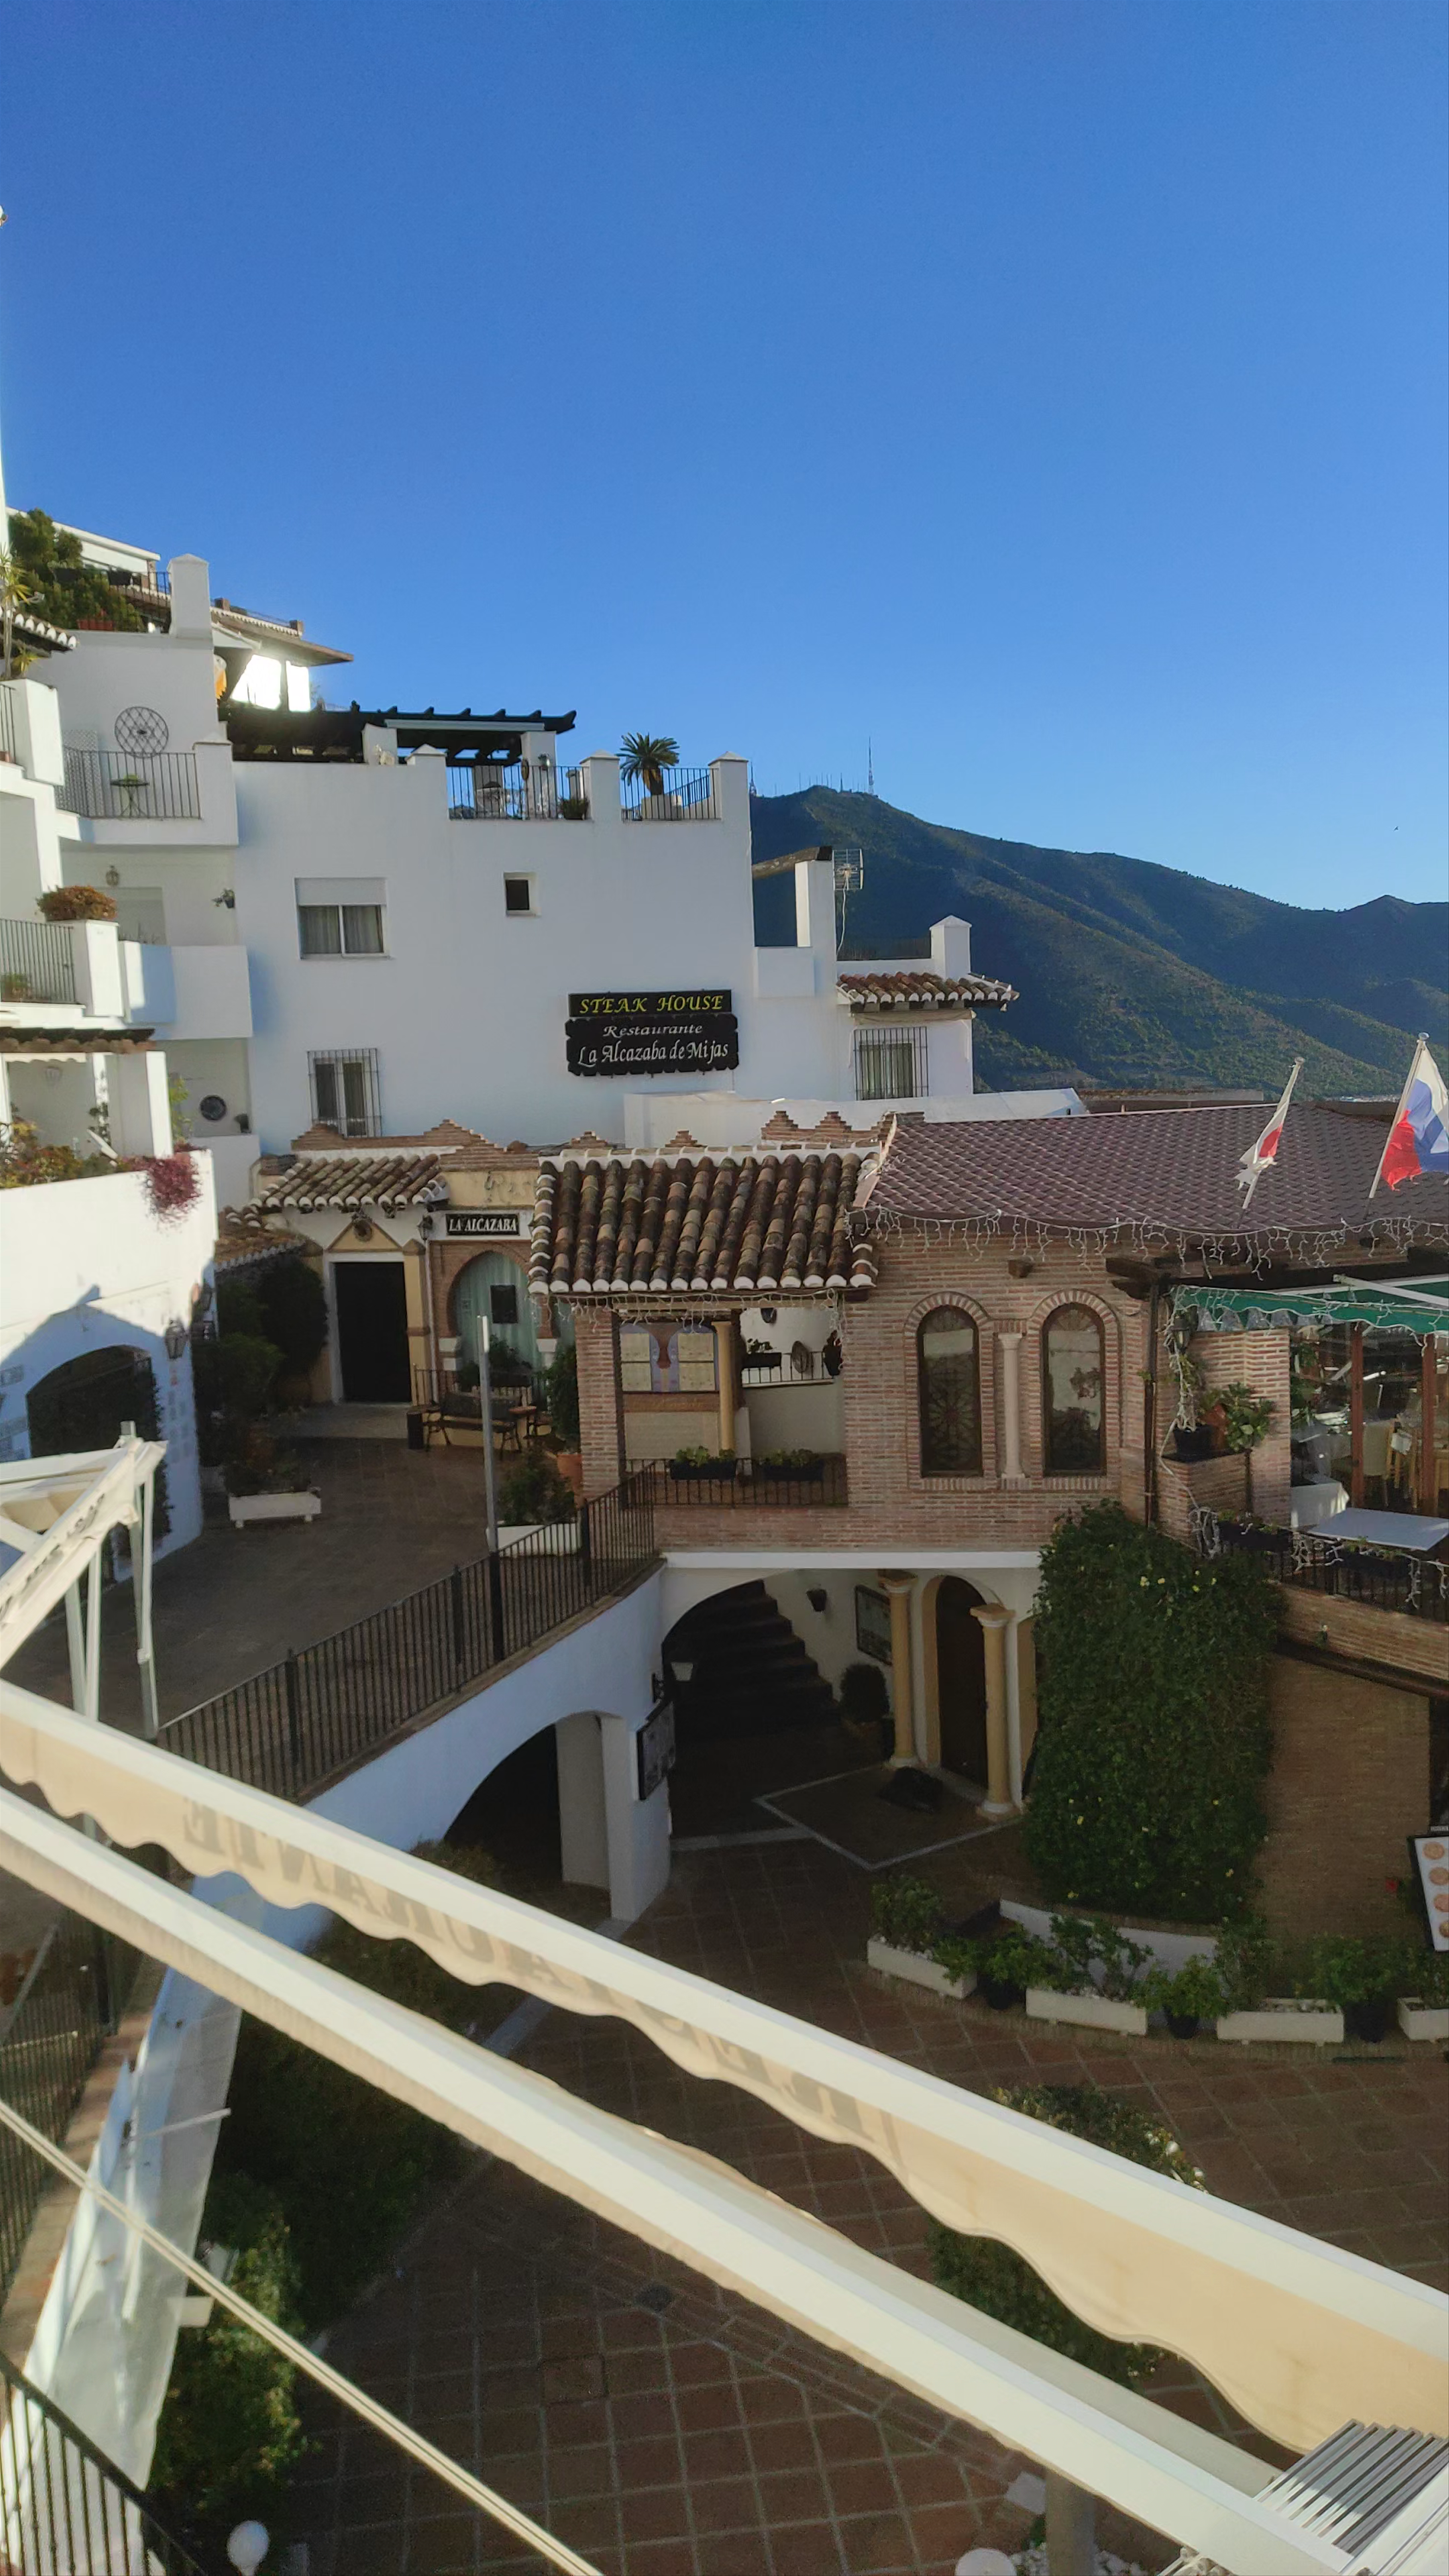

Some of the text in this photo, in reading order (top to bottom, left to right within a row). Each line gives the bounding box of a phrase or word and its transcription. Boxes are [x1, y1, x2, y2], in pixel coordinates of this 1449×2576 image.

[579, 995, 724, 1013] STEAK HOUSE
[603, 1024, 703, 1038] Restaurante
[577, 1040, 729, 1067] La Alcazaba de Mijas
[449, 1218, 517, 1232] LA ALCAZABA
